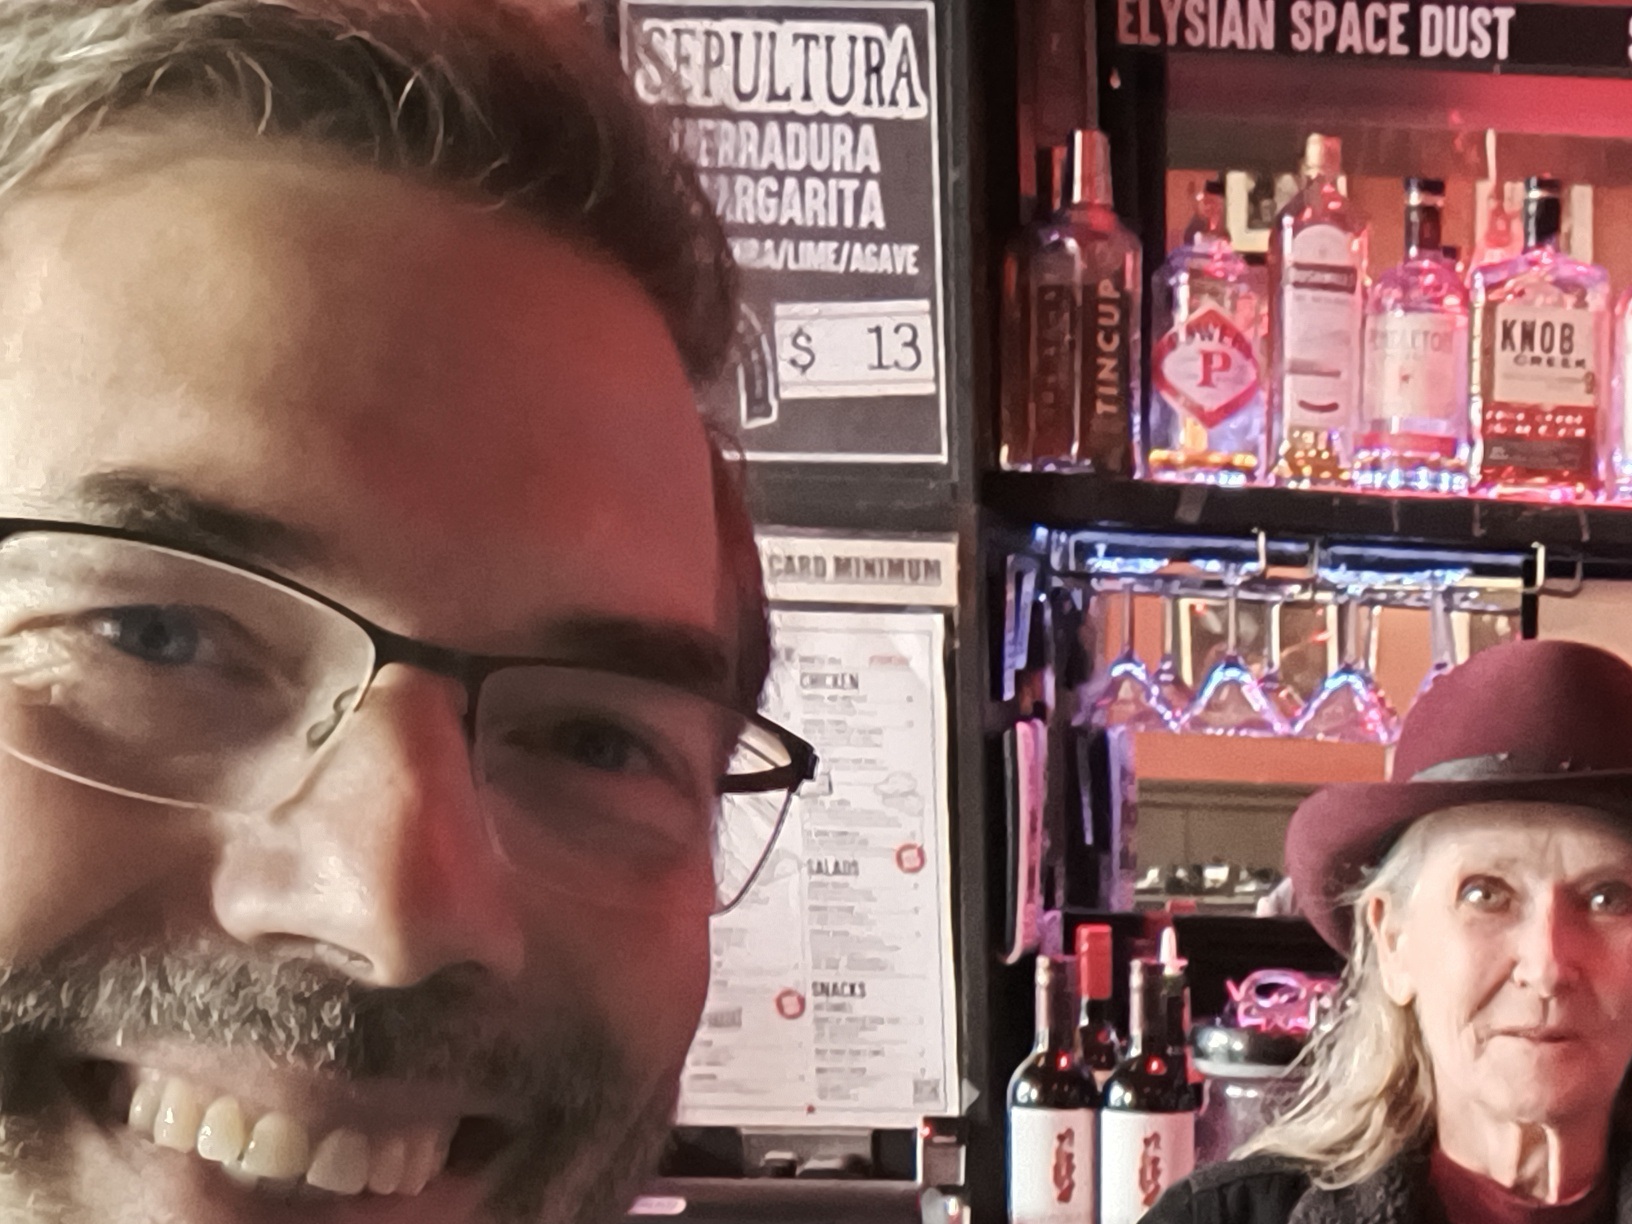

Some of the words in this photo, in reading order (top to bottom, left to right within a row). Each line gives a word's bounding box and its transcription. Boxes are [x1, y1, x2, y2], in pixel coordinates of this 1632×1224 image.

[1117, 0, 1276, 50] ELYSIAN
[1291, 1, 1410, 57] SPACE
[1420, 5, 1516, 61] DUST
[637, 22, 925, 114] SEPULTURA
[788, 328, 816, 375] $
[867, 323, 923, 371] 13
[1095, 278, 1121, 415] TINCUP
[1501, 319, 1576, 355] KNOB
[767, 554, 827, 579] CARD
[833, 556, 943, 581] MINIMUM
[800, 673, 859, 690] CHICKEN
[811, 981, 866, 998] SNACKS
